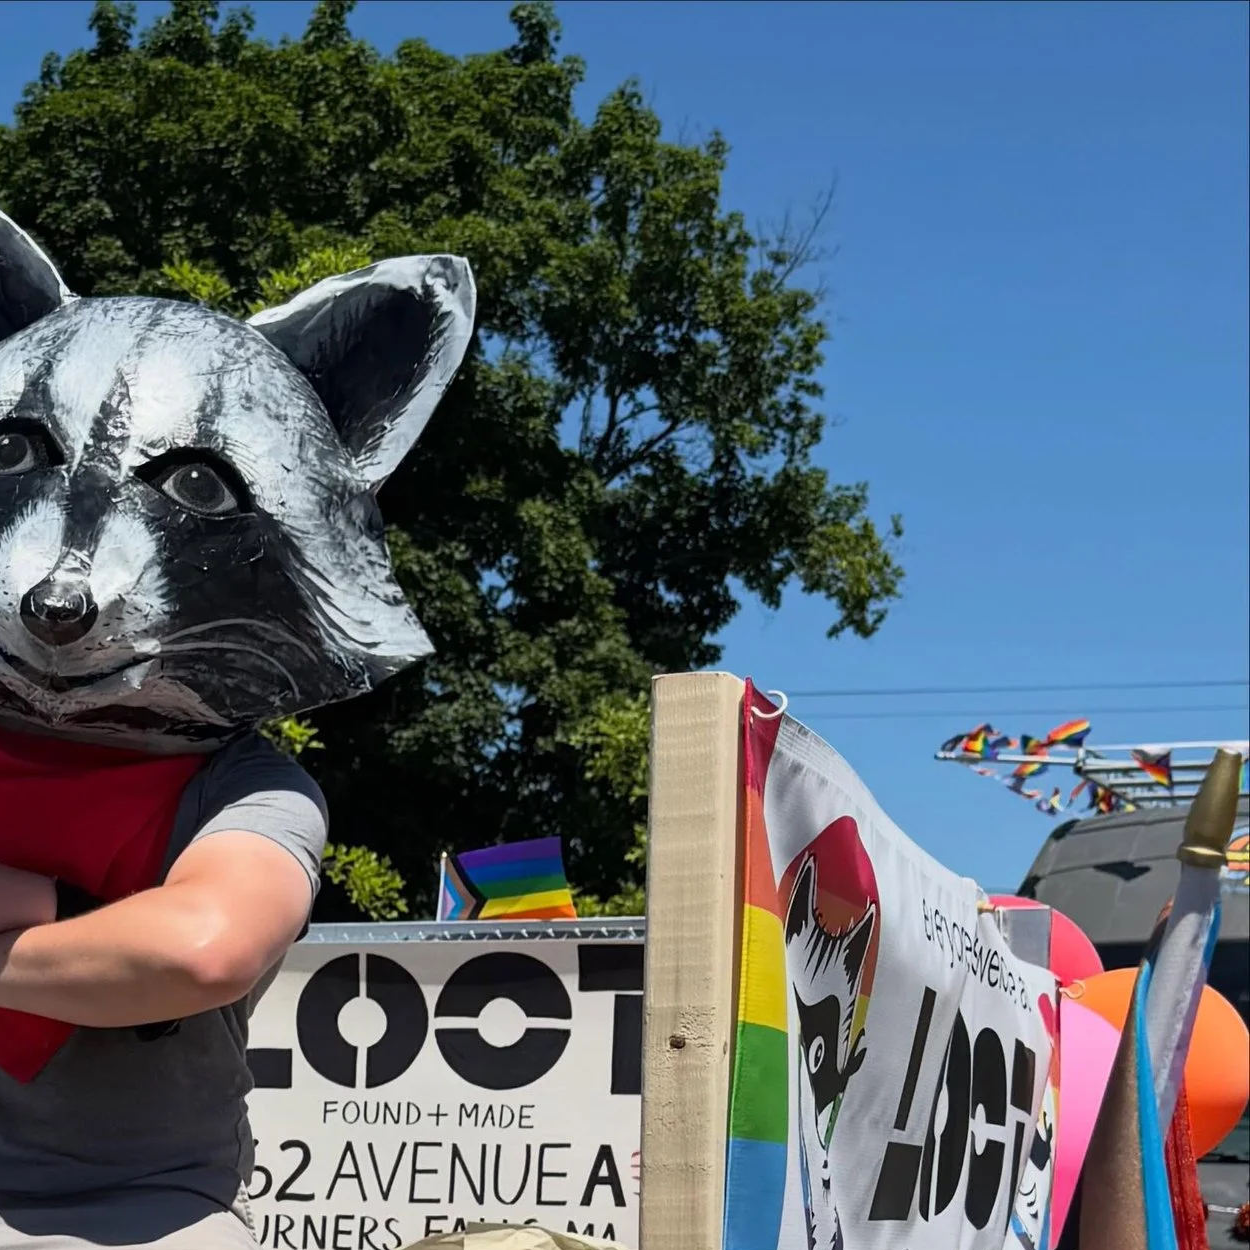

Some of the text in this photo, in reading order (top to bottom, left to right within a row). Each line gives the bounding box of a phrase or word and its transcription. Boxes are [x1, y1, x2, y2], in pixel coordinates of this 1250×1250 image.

[458, 1103, 535, 1129] MADE
[326, 1141, 571, 1206] AVENUE
[580, 1144, 627, 1207] A
